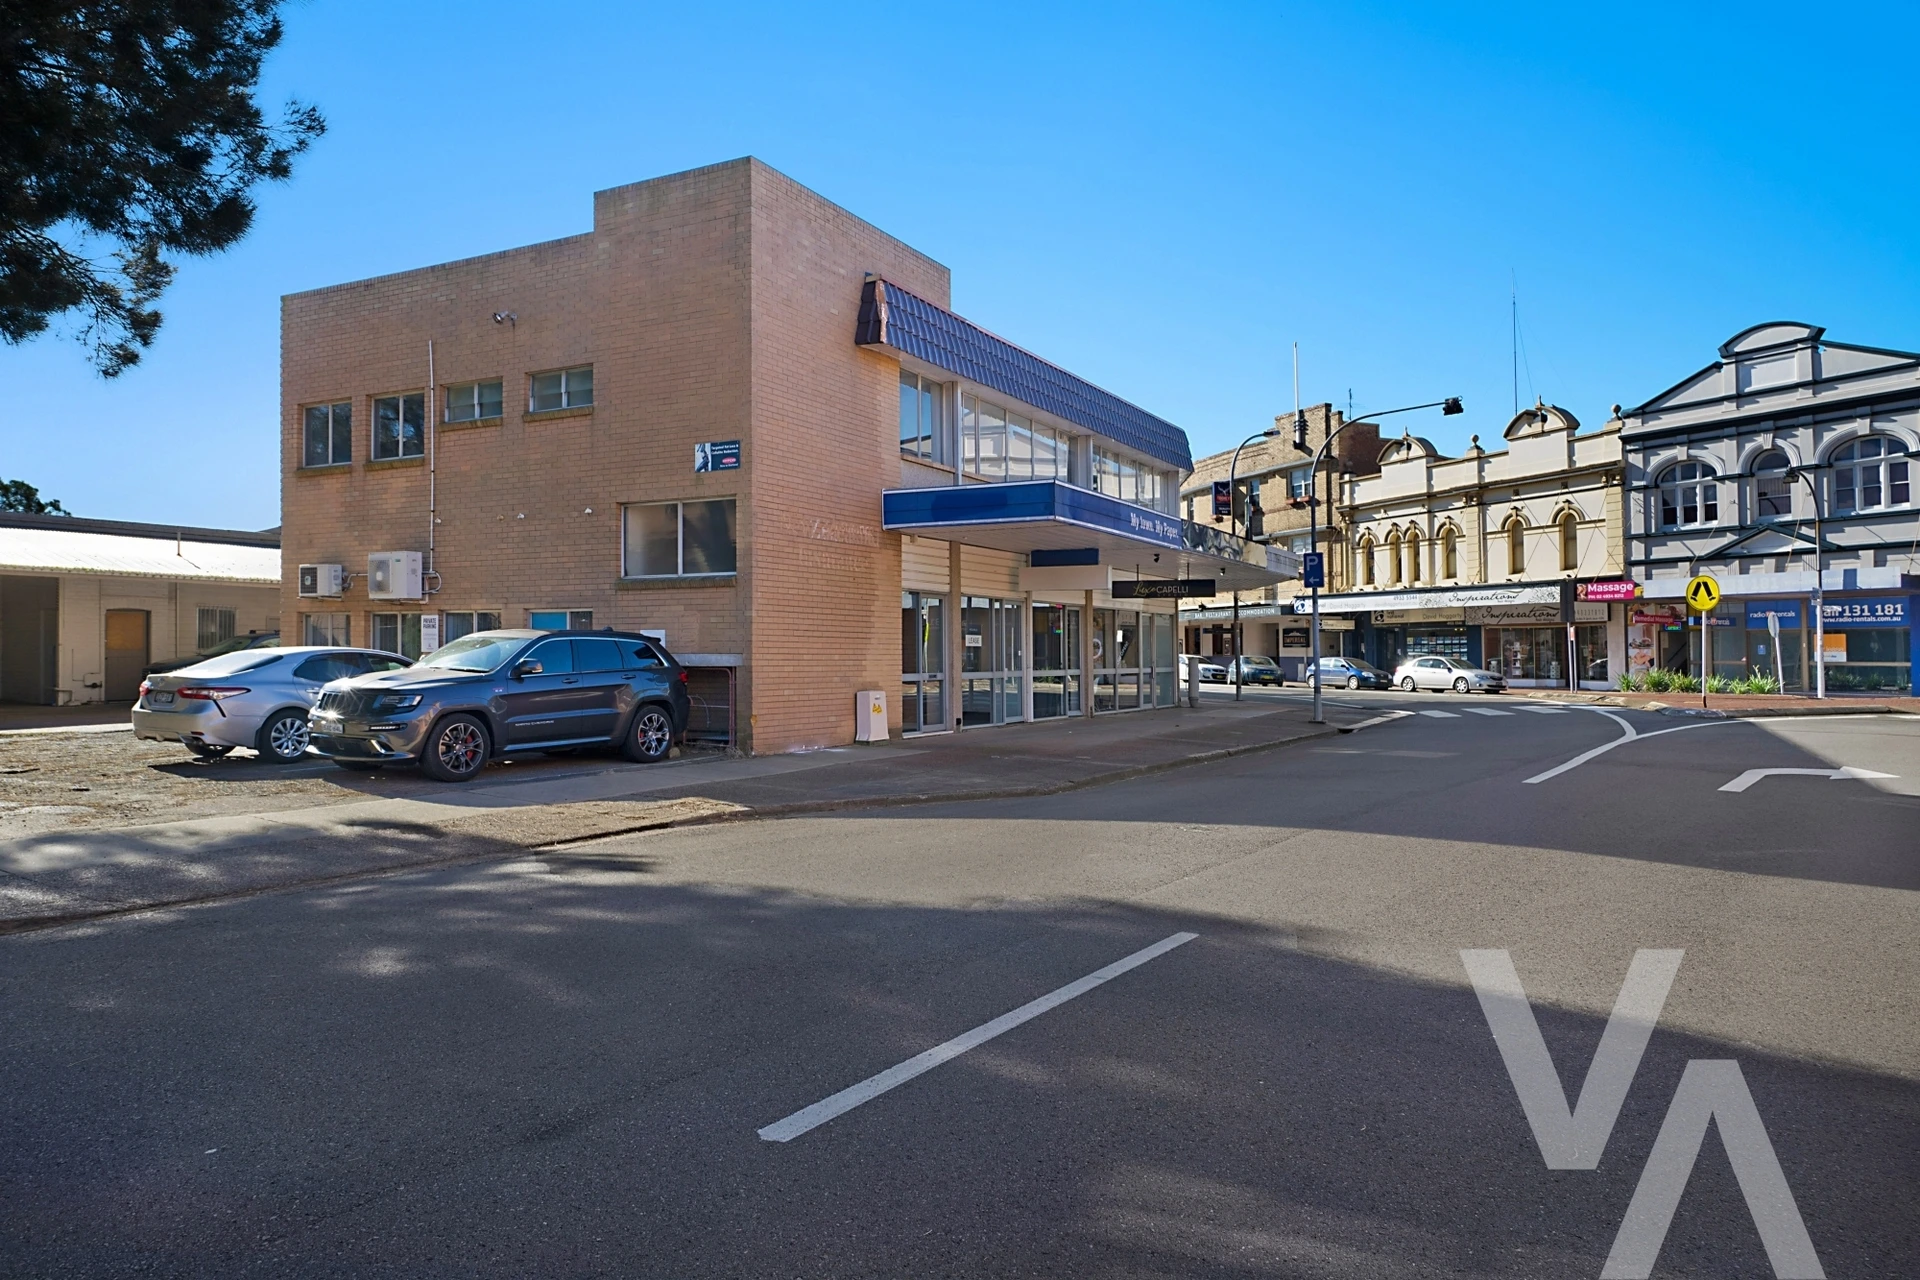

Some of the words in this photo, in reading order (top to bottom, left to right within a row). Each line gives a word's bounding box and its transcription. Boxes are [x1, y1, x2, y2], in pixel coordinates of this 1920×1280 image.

[1130, 512, 1140, 531] My
[1155, 520, 1163, 537] My
[1306, 555, 1319, 571] P
[1156, 586, 1189, 594] CAPELLI
[1588, 584, 1634, 593] Massage
[1449, 590, 1522, 606] Inspirations
[1481, 606, 1560, 623] Inspirations
[1843, 605, 1871, 616] 131
[1875, 604, 1904, 615] 181
